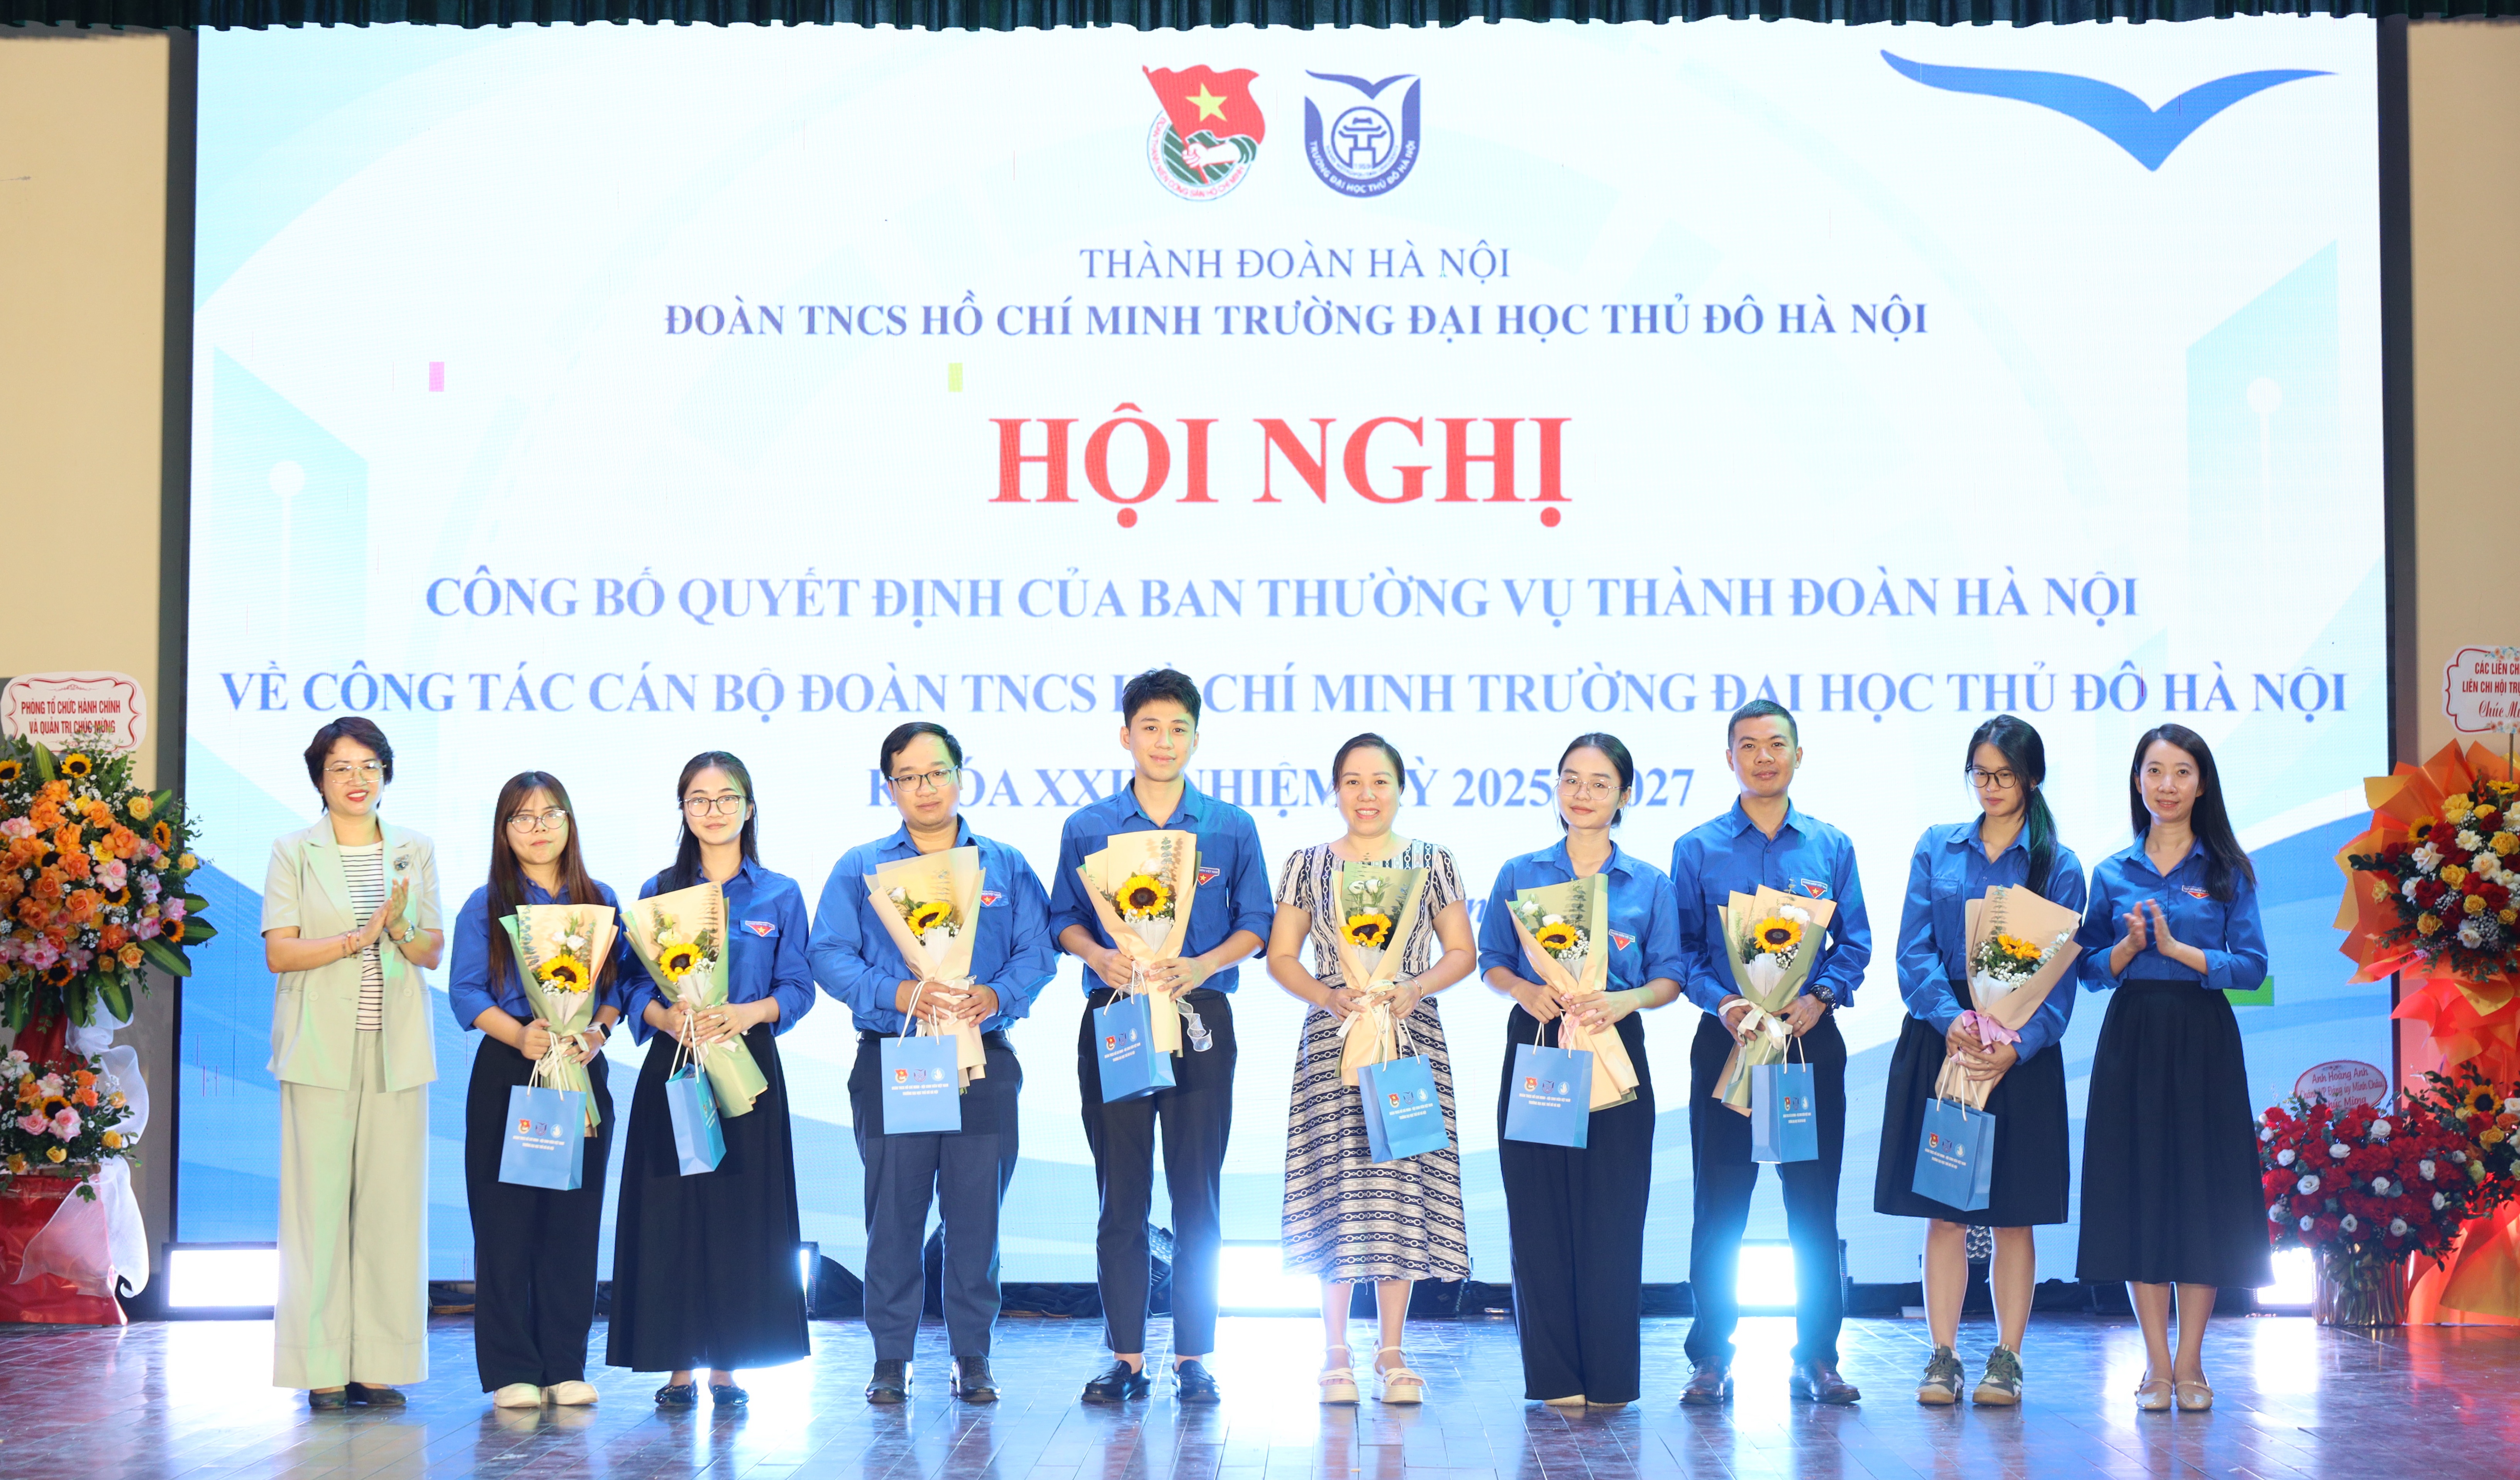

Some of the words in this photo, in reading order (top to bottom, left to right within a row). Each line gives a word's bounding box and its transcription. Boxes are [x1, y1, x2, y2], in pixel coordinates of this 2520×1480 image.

[1346, 183, 1367, 194] HỌC
[1080, 240, 1221, 278] THÀNH
[1237, 240, 1353, 279] ĐOÀN
[1369, 239, 1425, 278] HÀ
[1440, 239, 1509, 284] NỘI
[666, 295, 783, 336] ĐOÀN
[798, 305, 907, 336] TNCS
[922, 290, 983, 336] HỒ
[997, 296, 1072, 336] CHÍ
[1087, 306, 1200, 335] MINH
[1214, 295, 1394, 336] TRƯỜNG
[1409, 305, 1482, 343] ĐẠI
[1497, 305, 1588, 343] HỌC
[1602, 293, 1689, 335] THỦ
[1704, 294, 1764, 335] ĐÔ
[1778, 294, 1836, 334] HÀ
[1851, 294, 1927, 342] NỘI
[989, 403, 1218, 528] HỘI
[1253, 417, 1572, 527] NGHỊ
[427, 565, 576, 616] CÔNG
[595, 566, 665, 617] BỐ
[679, 565, 860, 625] QUYẾT
[872, 580, 1001, 628] ĐỊNH
[1018, 568, 1126, 617] CỦA
[1142, 580, 1243, 617] BAN
[1258, 567, 1488, 617] THƯỜNG
[1502, 579, 1572, 628] VỤ
[1588, 566, 1772, 616] THÀNH
[1789, 566, 1938, 617] ĐOÀN
[1957, 566, 2029, 616] HÀ
[2045, 571, 2136, 627] NỘI
[2475, 660, 2489, 674] CÁC
[2491, 660, 2507, 675] LIÊN
[2510, 663, 2520, 675] CH
[221, 661, 287, 710] VỀ
[303, 660, 453, 711] CÔNG
[469, 662, 574, 710] TÁC
[589, 662, 696, 712] CÁN
[716, 667, 784, 723] BỘ
[799, 662, 947, 712] ĐOÀN
[962, 674, 1096, 712] TNCS
[1202, 662, 1294, 712] CHÍ
[1312, 675, 1453, 712] MINH
[1468, 662, 1696, 712] TRƯỜNG
[1821, 673, 1933, 723] HỌC
[1947, 661, 2055, 712] THỦ
[2071, 660, 2148, 712] ĐÔ
[2163, 661, 2237, 712] HÀ
[2253, 666, 2347, 723] NỘI
[2462, 678, 2478, 693] LIÊN
[2481, 681, 2492, 693] CHI
[2495, 679, 2506, 696] HỘI
[21, 698, 45, 714] PHÒNG
[47, 695, 56, 714] TỔ
[58, 698, 76, 714] CHỨC
[78, 697, 97, 714] HÀNH
[99, 697, 120, 713] CHÍNH
[2479, 700, 2504, 717] Chúc
[29, 718, 38, 734] VÀ
[40, 716, 59, 735] QUẢN
[61, 721, 72, 737] TRỊ
[74, 717, 93, 734] CHÚC
[95, 717, 115, 733] MỪNG
[867, 756, 1024, 807] KÓA
[1452, 768, 1553, 807] 2025
[2312, 1074, 2327, 1084] Anh
[2328, 1070, 2351, 1082] Hoàng
[2353, 1068, 2369, 1079] Anh
